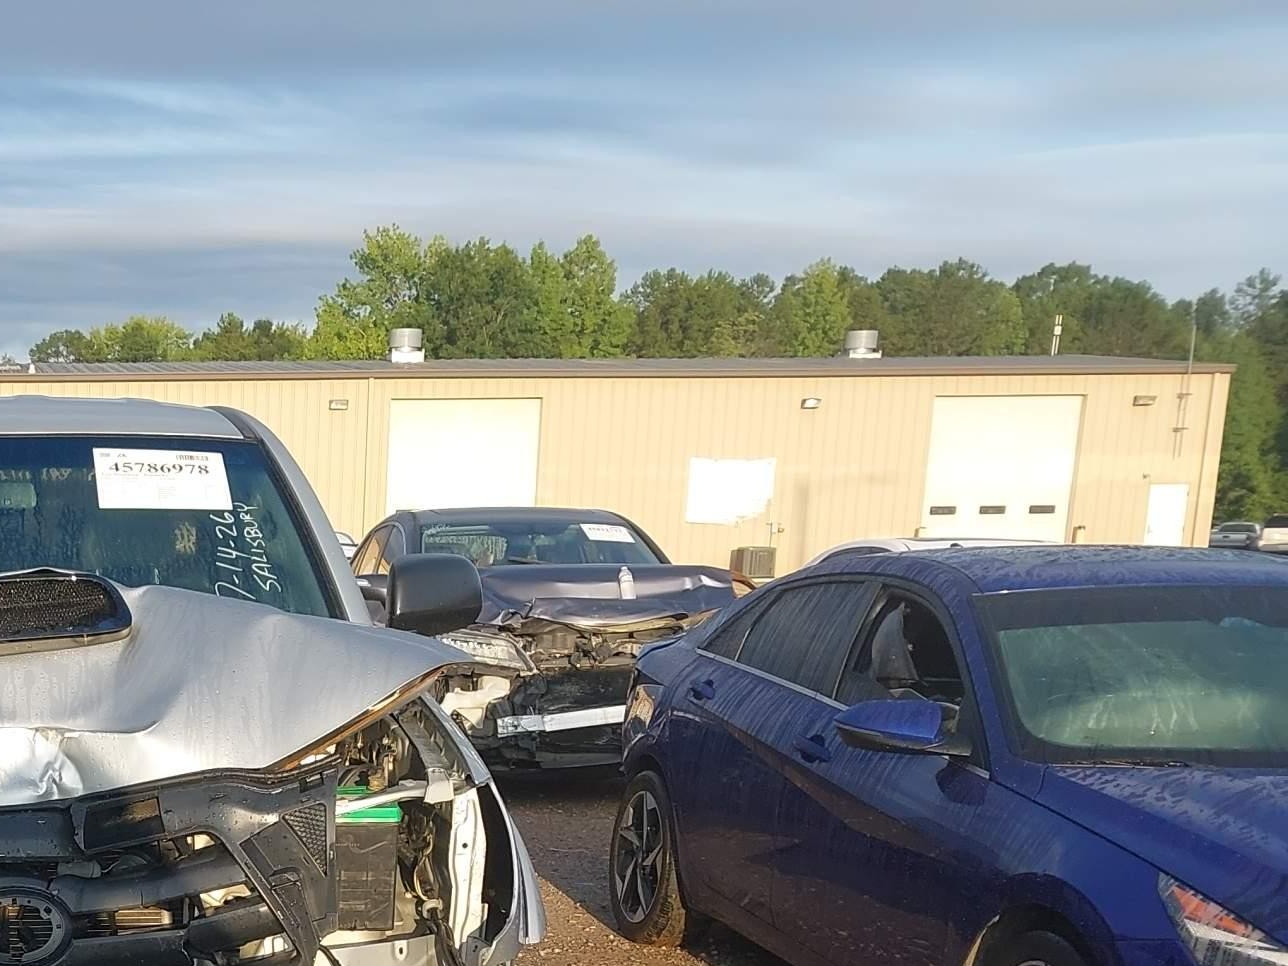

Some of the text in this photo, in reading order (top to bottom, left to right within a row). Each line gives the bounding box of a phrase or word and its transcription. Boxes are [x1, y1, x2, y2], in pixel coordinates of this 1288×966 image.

[109, 462, 210, 475] 45786978
[209, 512, 257, 600] 7-14-26
[233, 502, 282, 592] SALISBURY
